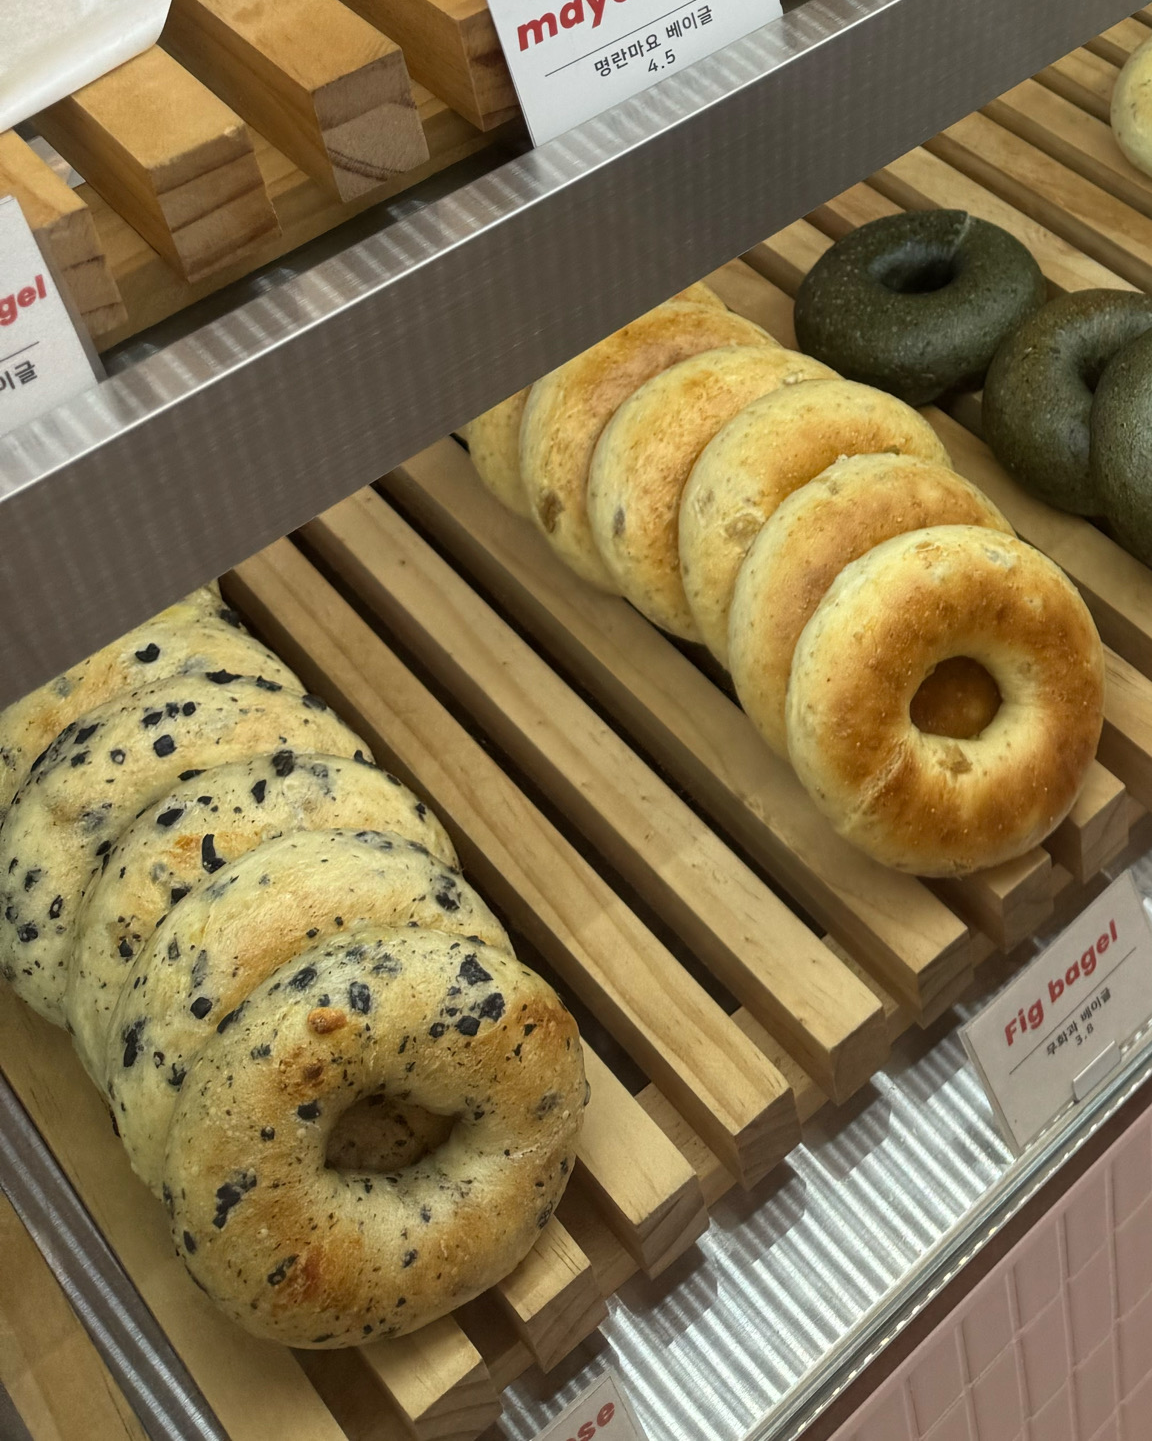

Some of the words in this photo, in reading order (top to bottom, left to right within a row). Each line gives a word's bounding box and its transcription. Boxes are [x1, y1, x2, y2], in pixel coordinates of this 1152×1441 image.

[594, 33, 662, 77] 명란마요
[665, 4, 713, 39] 베이글
[647, 48, 676, 73] 4.5
[1004, 997, 1045, 1047] Fig
[1047, 918, 1118, 1004] bagel
[1046, 1021, 1078, 1056] 무화과
[1080, 987, 1111, 1022] 베이글
[1076, 1023, 1094, 1046] 3.8
[566, 1402, 615, 1441] se
